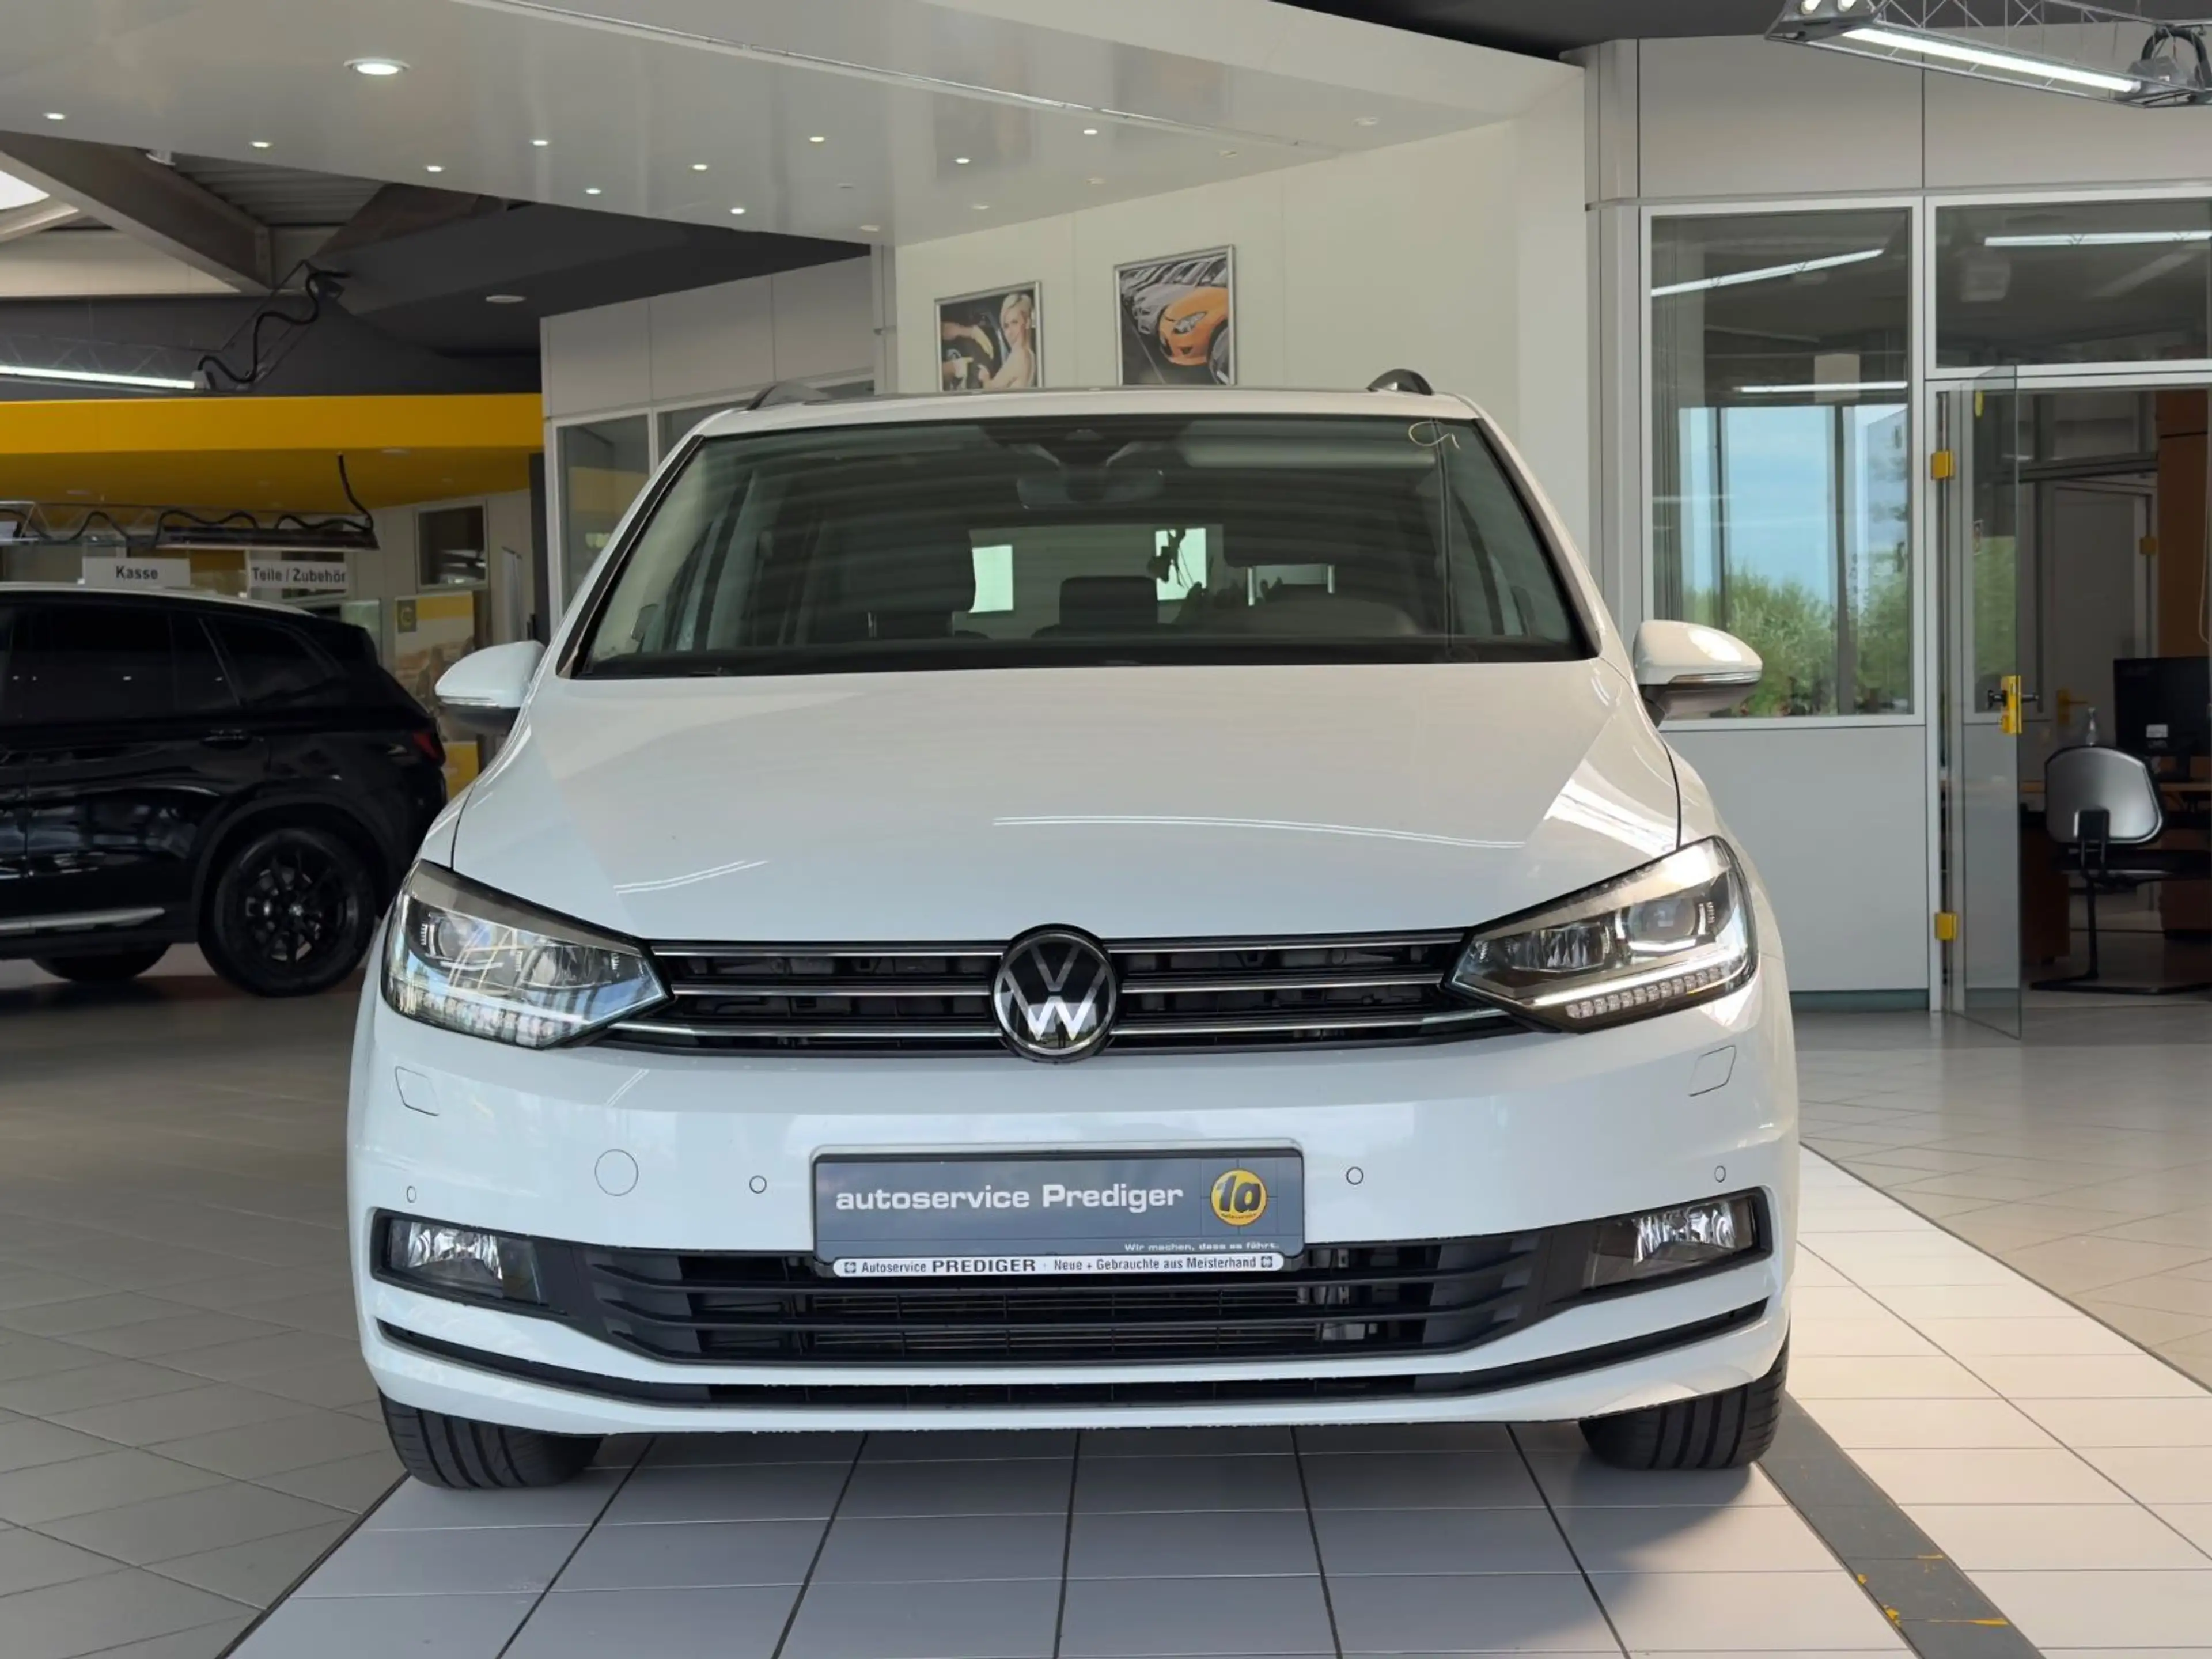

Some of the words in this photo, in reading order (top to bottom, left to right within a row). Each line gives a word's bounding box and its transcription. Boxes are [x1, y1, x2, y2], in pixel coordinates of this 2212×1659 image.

[116, 565, 158, 579] Kasse
[252, 567, 282, 581] Teile
[292, 567, 346, 583] Zubehör
[836, 1184, 1030, 1210] autoservice
[1042, 1183, 1184, 1213] Prediger
[1217, 1175, 1261, 1213] 1a
[1124, 1242, 1145, 1252] Wir
[861, 1262, 927, 1273] Autoservice
[931, 1259, 1036, 1273] PREDIGER
[1054, 1260, 1082, 1271] Neue
[1096, 1258, 1160, 1271] Gebrauchte
[1163, 1259, 1183, 1270] aus
[1186, 1256, 1257, 1269] Meisterhand
